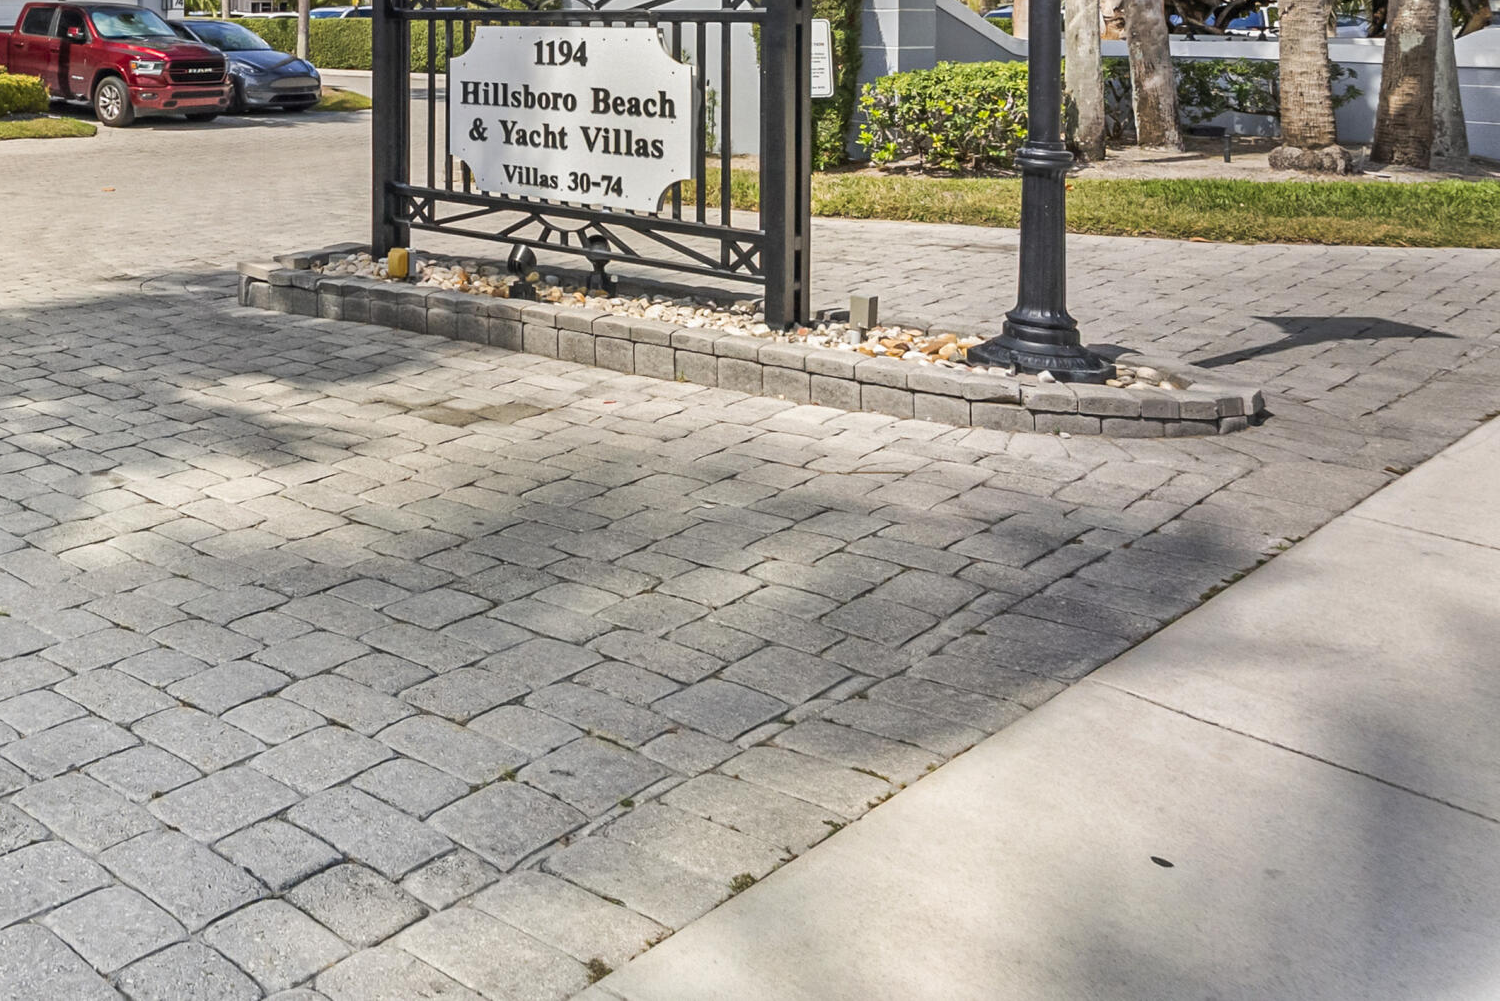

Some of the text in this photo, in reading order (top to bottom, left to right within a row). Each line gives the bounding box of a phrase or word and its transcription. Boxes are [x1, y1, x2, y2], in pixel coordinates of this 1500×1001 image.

[533, 39, 588, 67] 1194
[460, 80, 677, 119] Hillsboro Beach
[468, 117, 664, 159] & Yacht Villas
[502, 164, 623, 197] Villas 30-74
